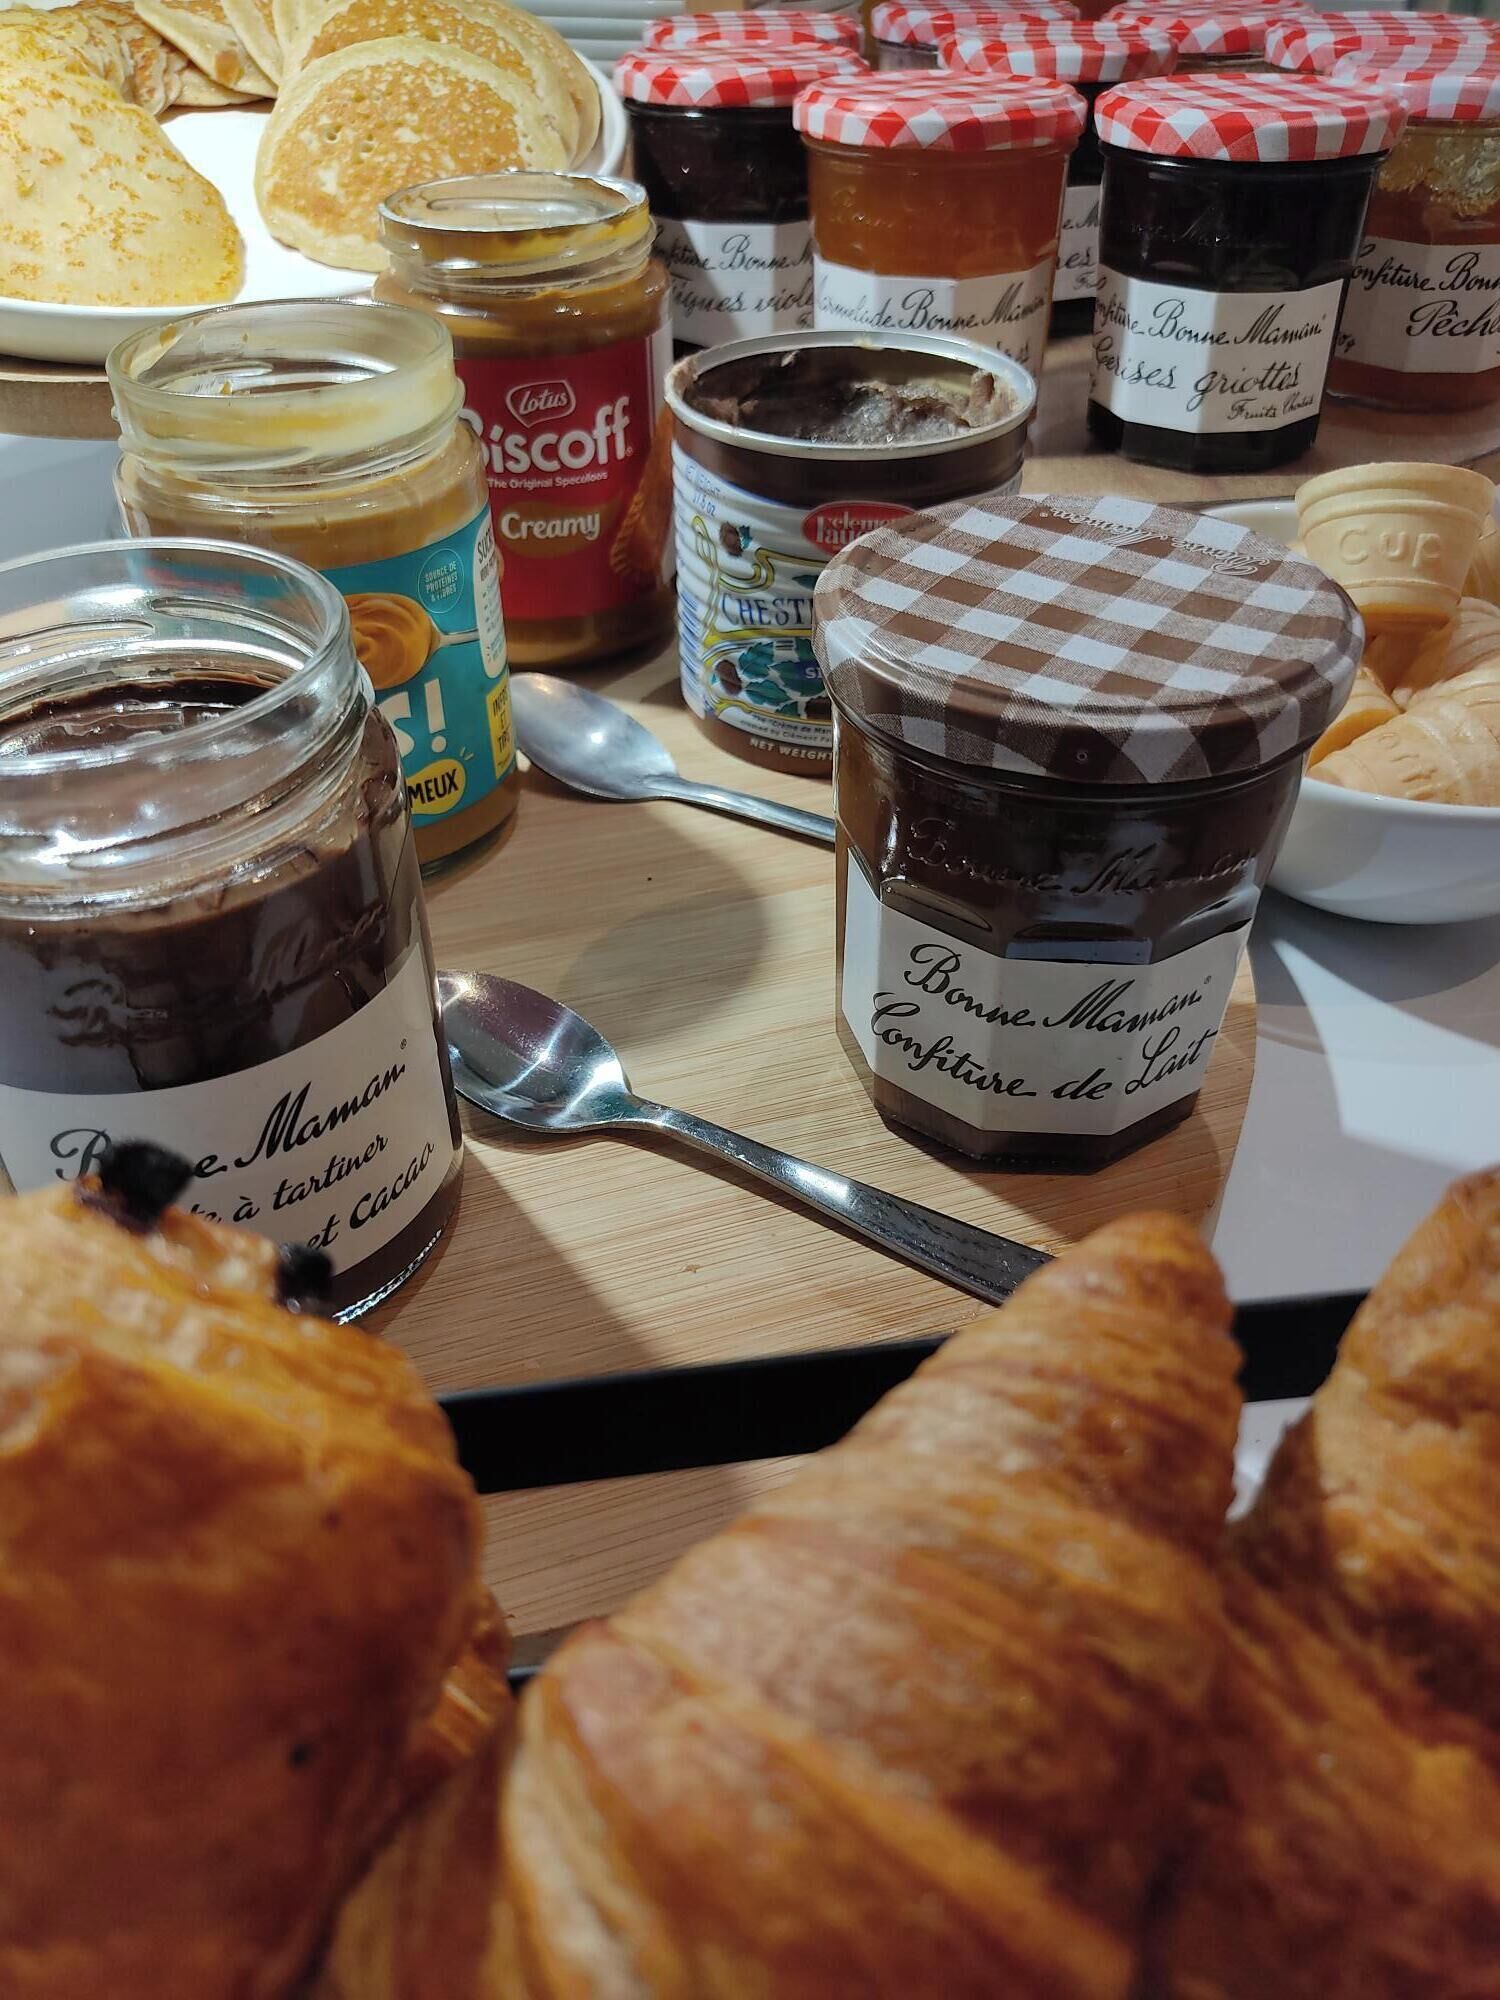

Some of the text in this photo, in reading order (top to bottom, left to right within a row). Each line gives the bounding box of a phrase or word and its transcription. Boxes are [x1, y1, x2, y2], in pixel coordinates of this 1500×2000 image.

[719, 234, 791, 271] Bonne
[898, 288, 980, 330] Bonne
[1148, 299, 1230, 346] Bonne
[1233, 303, 1322, 345] Maman
[518, 388, 568, 416] Lotus
[1187, 361, 1302, 412] griottes
[1227, 398, 1278, 420] Fruits
[487, 471, 609, 491] The Original Speculoos
[501, 511, 601, 541] Creamy
[750, 737, 776, 752] NET
[903, 943, 1036, 1027] Bonne
[870, 991, 1218, 1100] Confiture de Lait
[233, 1195, 260, 1224] à
[272, 1132, 389, 1212] tartiner
[348, 1141, 436, 1229] Cacao
